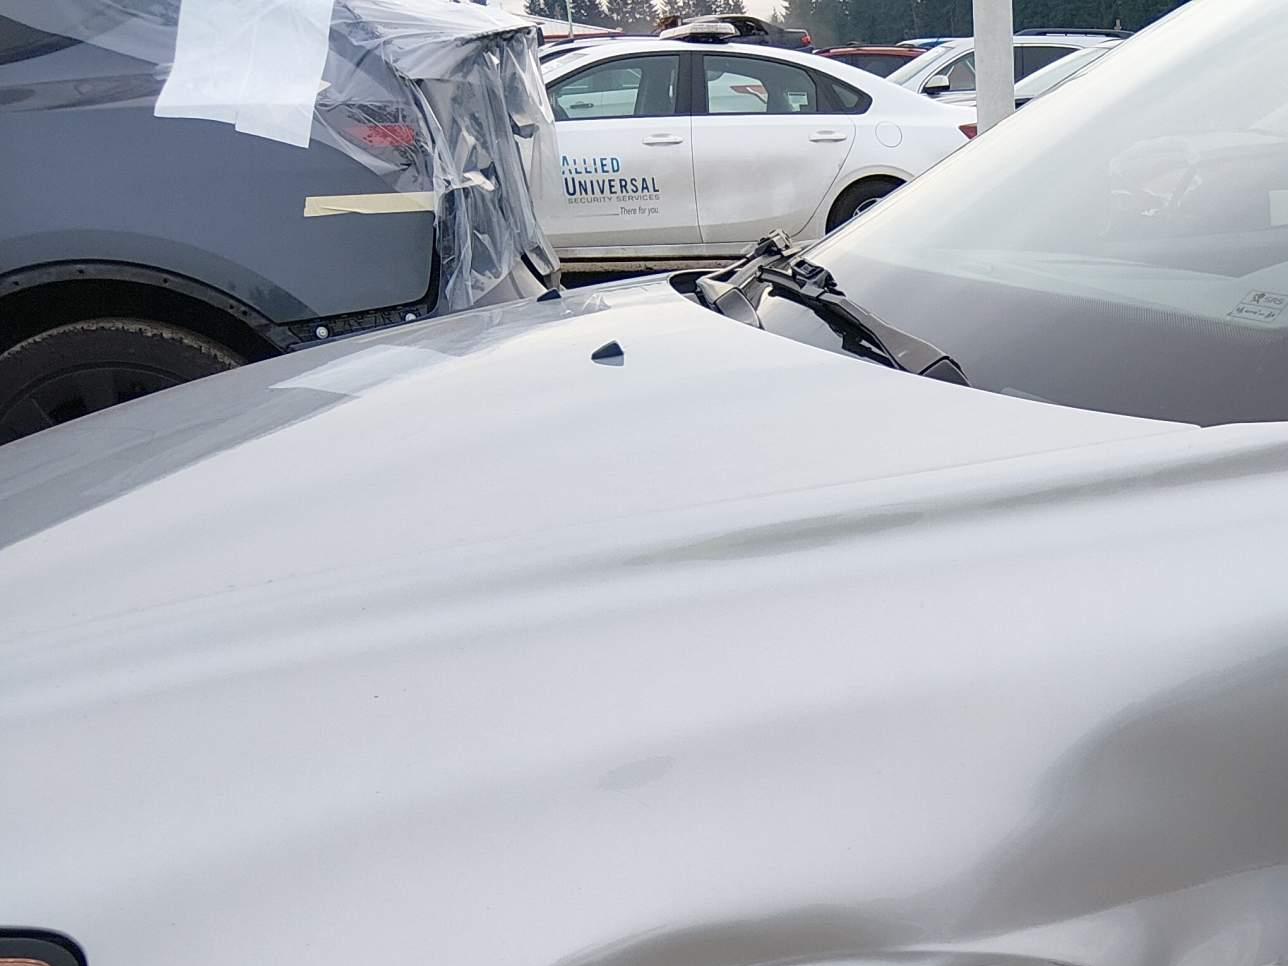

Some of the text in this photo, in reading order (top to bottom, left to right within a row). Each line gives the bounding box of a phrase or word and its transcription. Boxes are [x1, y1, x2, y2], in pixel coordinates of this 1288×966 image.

[562, 155, 620, 175] ALLIED
[564, 177, 660, 196] UNIVERSAL
[568, 194, 660, 205] SECURITY SERVICES
[620, 206, 637, 215] There
[638, 206, 647, 215] for
